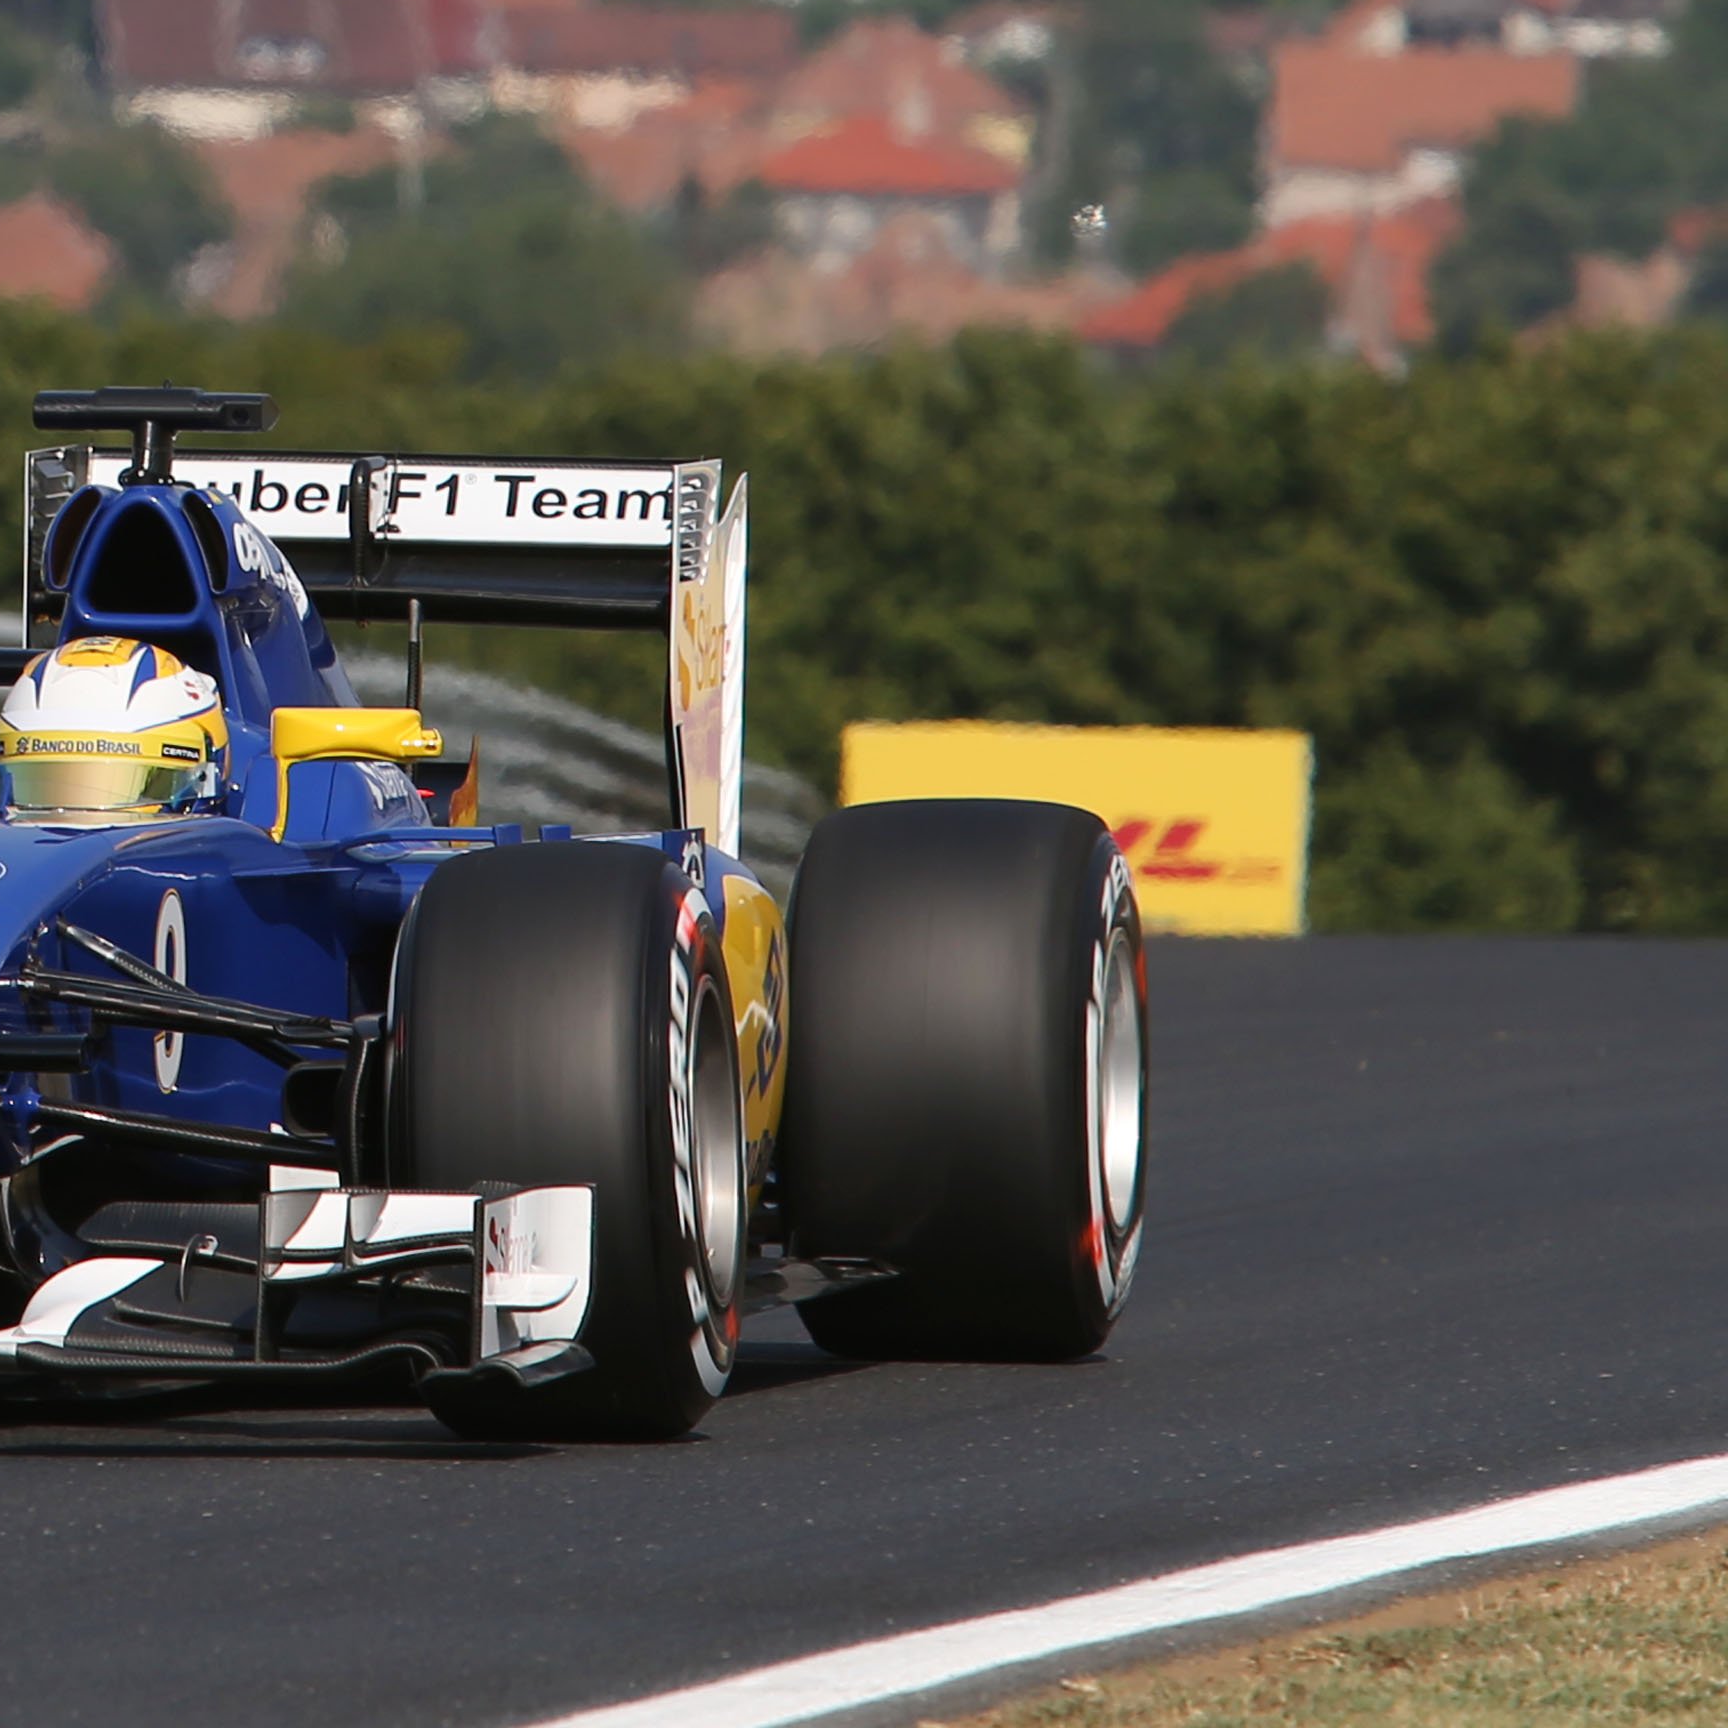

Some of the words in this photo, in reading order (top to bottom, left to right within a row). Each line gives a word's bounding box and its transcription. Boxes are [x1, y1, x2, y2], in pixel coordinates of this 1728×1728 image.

[495, 474, 674, 521] Team
[31, 738, 74, 752] BANCO
[76, 741, 94, 753] DO
[96, 739, 142, 755] BRASIL
[162, 746, 200, 760] CERTINA
[668, 948, 697, 1240] ZERO
[684, 1266, 709, 1324] P
